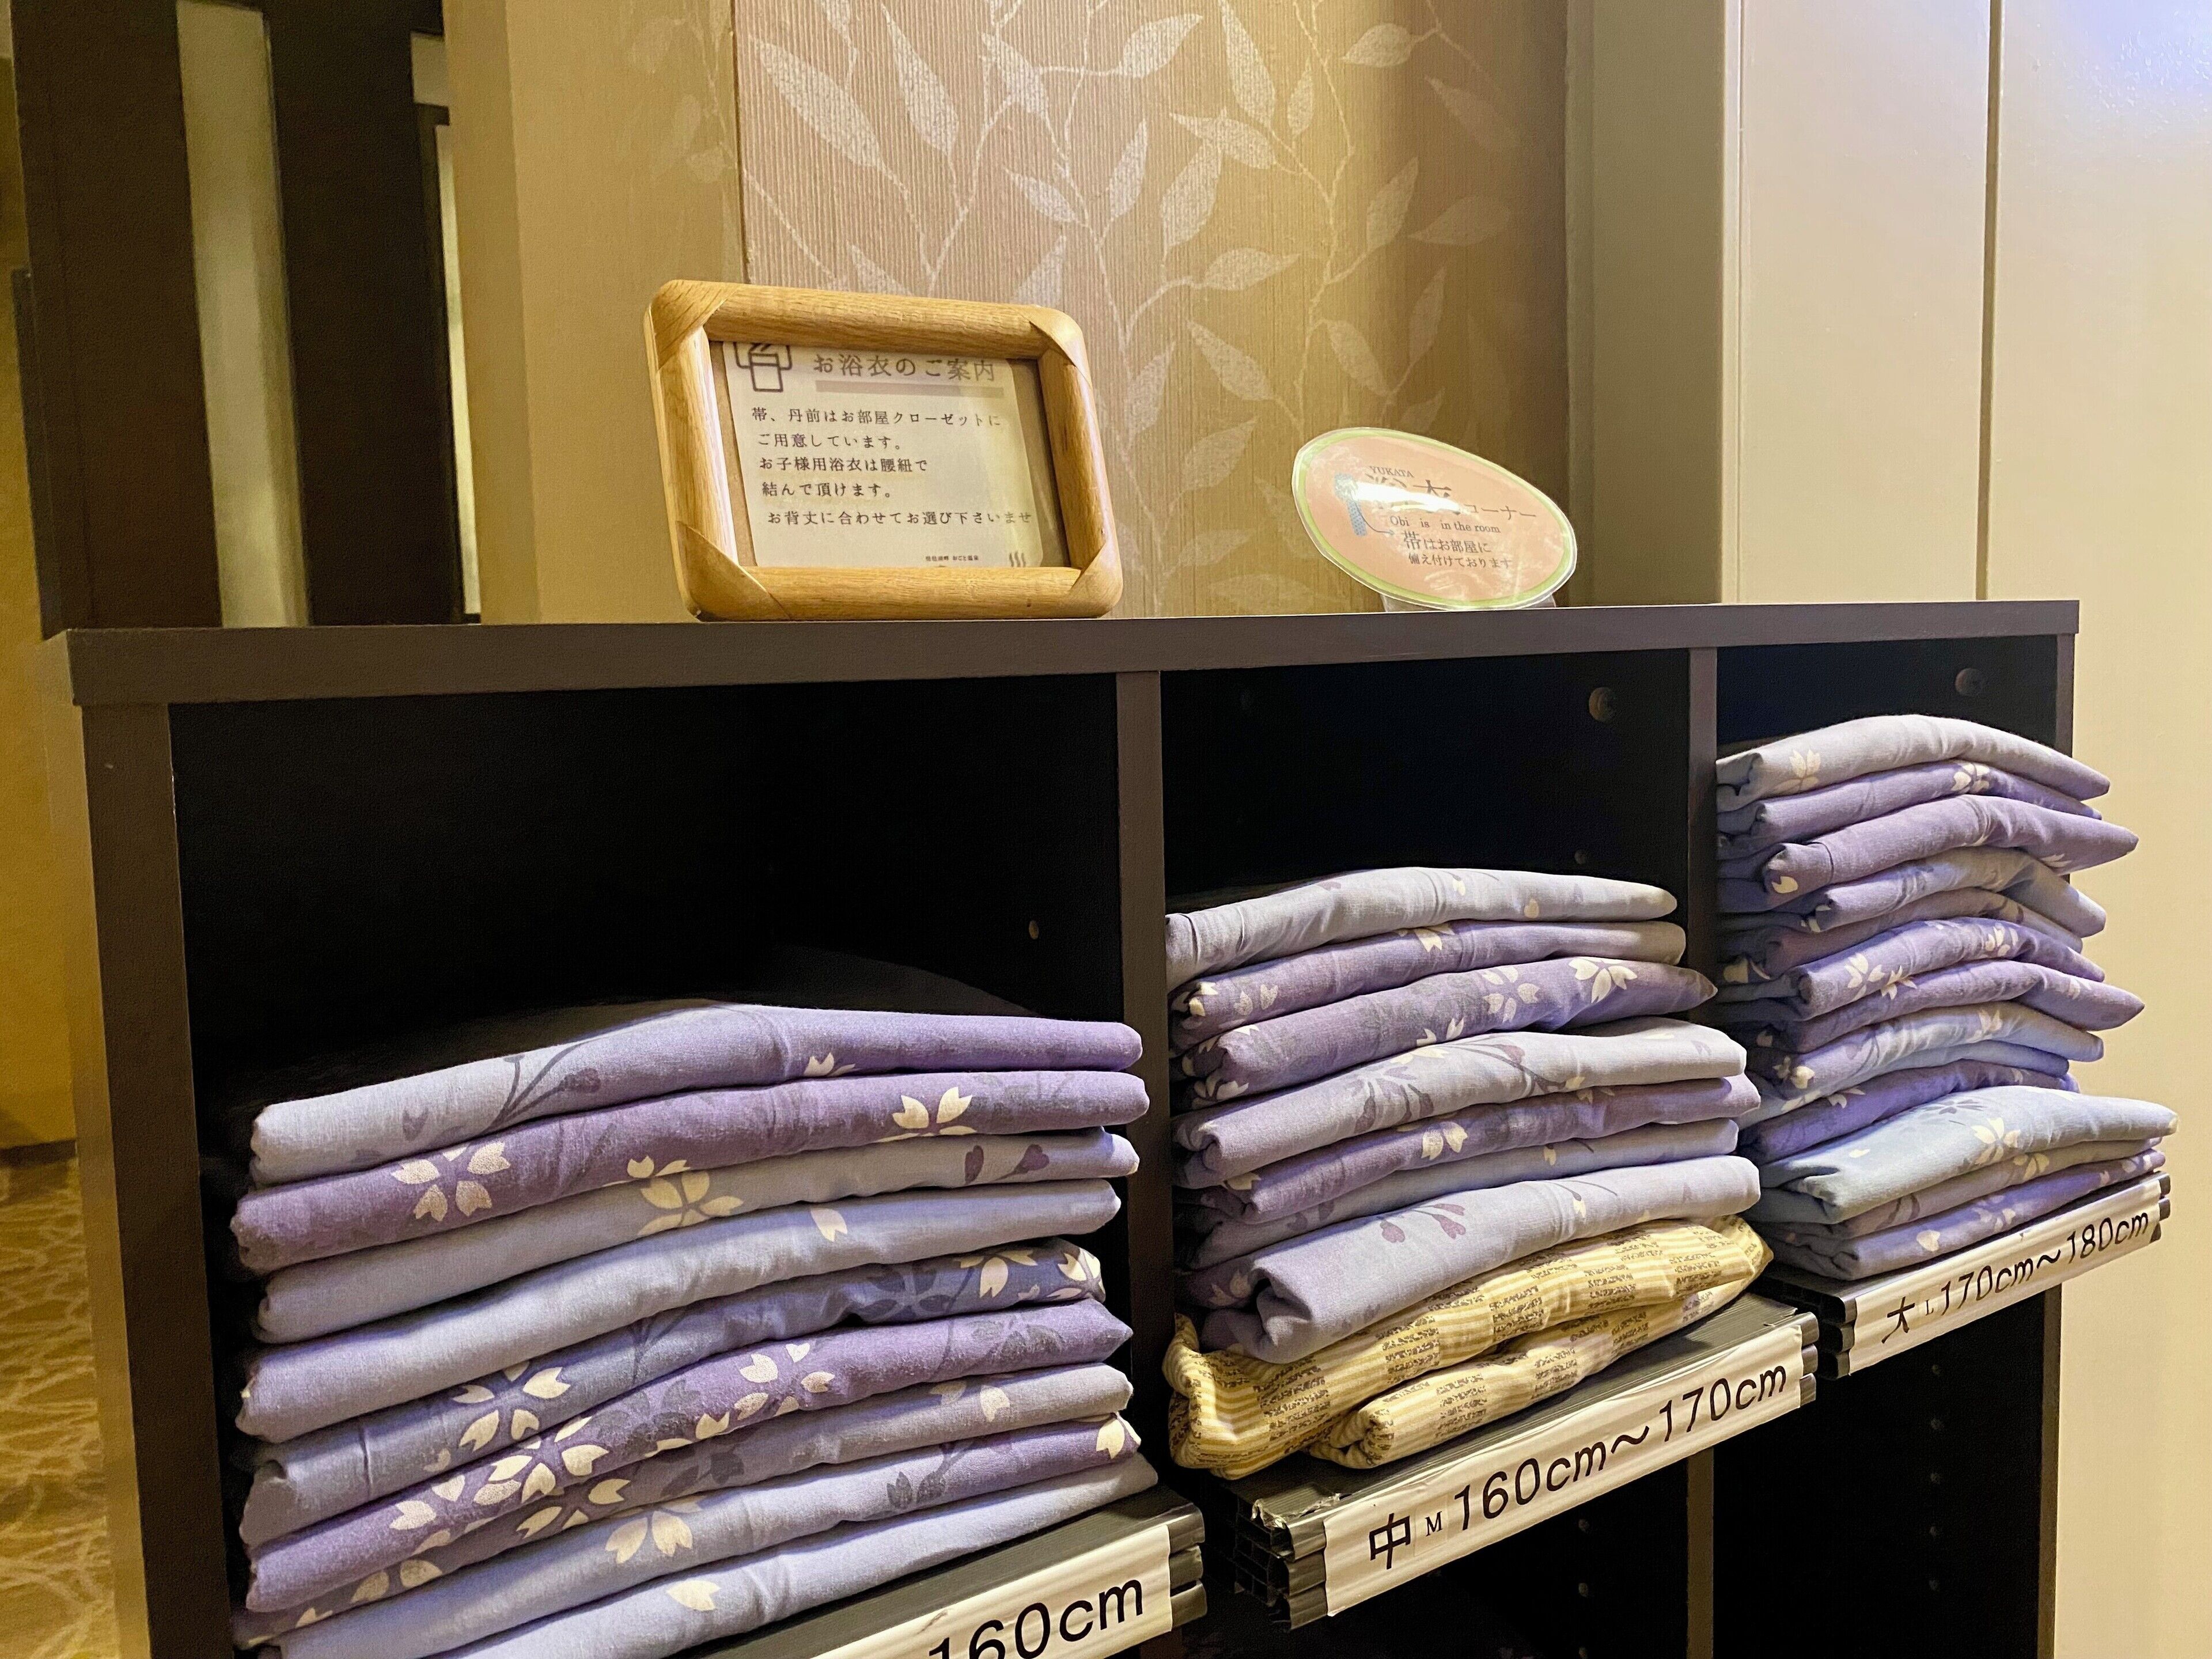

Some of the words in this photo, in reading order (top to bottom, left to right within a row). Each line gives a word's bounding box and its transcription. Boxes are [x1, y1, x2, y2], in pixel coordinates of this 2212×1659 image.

[813, 354, 995, 382] お浴衣のご案内
[752, 407, 1001, 427] 帯、丹前はお部屋クローゼットに
[757, 432, 902, 450] ご用意しています。
[759, 457, 927, 473] お子様用浴衣は腰紐で
[1369, 466, 1415, 478] YUKATA
[762, 482, 891, 498] 結んで頂けます。
[768, 510, 1032, 525] お背丈に合わせてお選び下さいませ
[1390, 515, 1410, 527] Obi
[1421, 518, 1430, 528] is
[1440, 520, 1452, 530] in
[1454, 521, 1471, 532] the
[1475, 525, 1501, 533] room
[1401, 531, 1492, 554] 帯はお部屋に
[1408, 554, 1513, 569] 備え付けております
[1881, 1296, 1915, 1344] 大
[1925, 1300, 1935, 1316] L
[1369, 1513, 1411, 1570] 中
[1424, 1510, 1443, 1537] M
